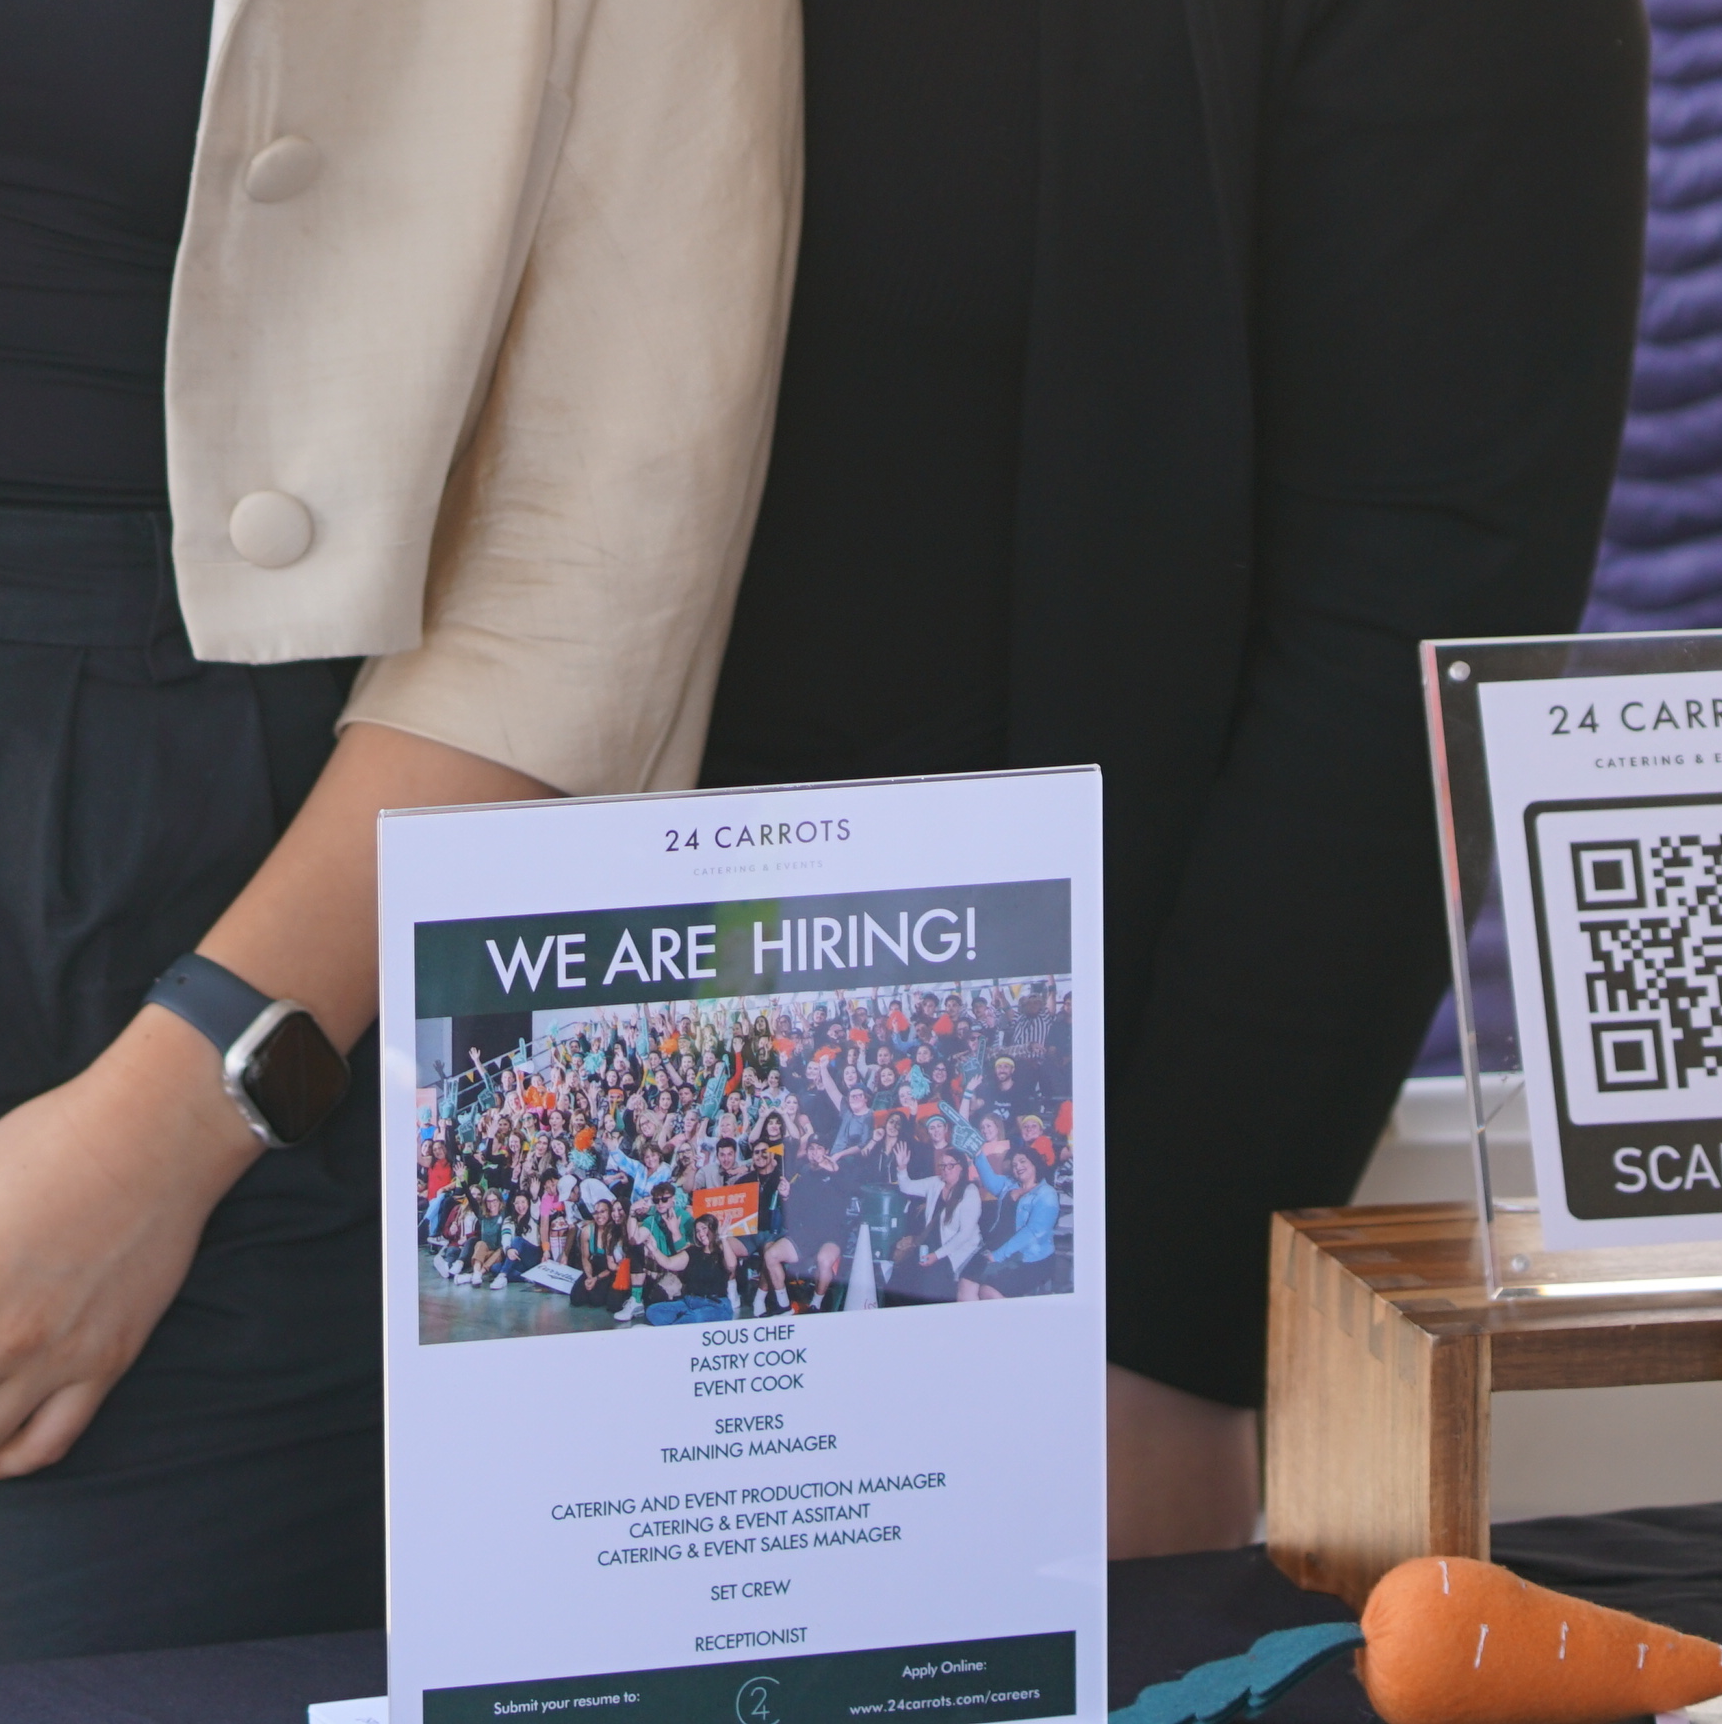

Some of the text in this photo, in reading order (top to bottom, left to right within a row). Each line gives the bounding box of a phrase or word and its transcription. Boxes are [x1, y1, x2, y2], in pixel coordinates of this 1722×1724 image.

[1549, 704, 1599, 736] 24
[1595, 754, 1685, 769] CATERING
[1695, 753, 1704, 765] &
[665, 818, 851, 852] 24 CARROTS
[693, 860, 823, 876] CATERING & EVENTS
[485, 906, 977, 994] WE ARE HIRING!
[701, 1324, 795, 1347] SOUS CHEF
[690, 1348, 807, 1373] PASTRY COOK
[694, 1372, 805, 1398] EVENT COOK
[715, 1413, 784, 1435] SERVERS
[660, 1434, 837, 1464] TRAINING MANAGER
[551, 1472, 947, 1521] CATERING AND EVENT PRODUCTION MANAGER
[629, 1502, 871, 1539] CATERING & EVENT ASSITANT
[597, 1525, 902, 1567] CATERING & EVENT SALES MANAGER
[710, 1578, 791, 1602] SET CREW
[695, 1626, 808, 1652] RECEPTIONIST
[901, 1658, 987, 1680] Apply Online:
[493, 1691, 640, 1716] Submit your resume to:
[849, 1688, 1041, 1716] www.24carrots.com/careers
